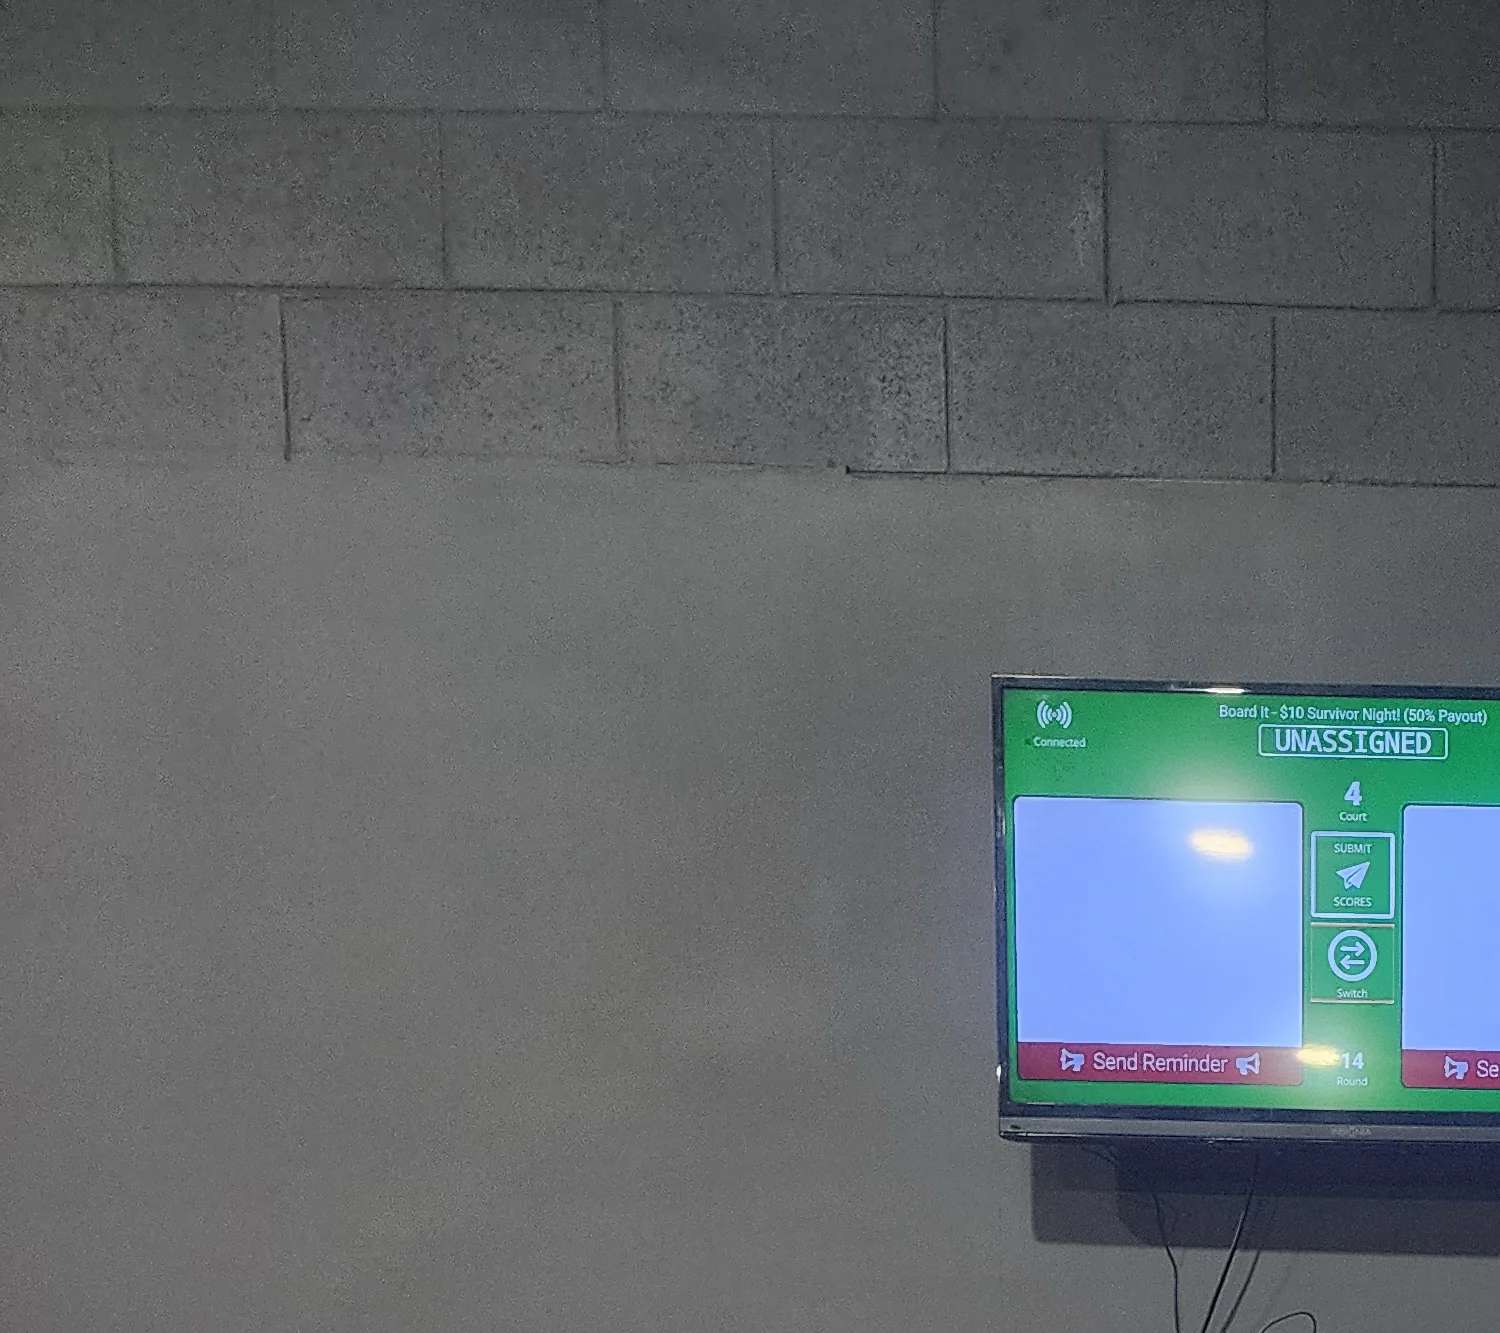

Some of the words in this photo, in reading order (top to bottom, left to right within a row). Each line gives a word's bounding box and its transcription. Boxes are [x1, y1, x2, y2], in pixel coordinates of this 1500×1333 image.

[1219, 704, 1257, 719] Board
[1260, 705, 1270, 719] It
[1279, 703, 1305, 721] $10
[1306, 706, 1360, 720] Survivor
[1362, 707, 1401, 724] Night!
[1403, 707, 1436, 725] (50%
[1438, 709, 1488, 726] Payout)
[1032, 736, 1087, 748] Connected
[1274, 728, 1432, 755] UNASSIGNED
[1344, 781, 1363, 806] 4
[1339, 812, 1368, 822] Court
[1333, 843, 1373, 854] SUBMIT
[1333, 896, 1373, 908] SCORES
[1336, 987, 1368, 999] Switch
[1093, 1051, 1138, 1072] Send
[1143, 1053, 1229, 1074] Reminder
[1341, 1052, 1365, 1070] 14
[1336, 1076, 1369, 1087] Round
